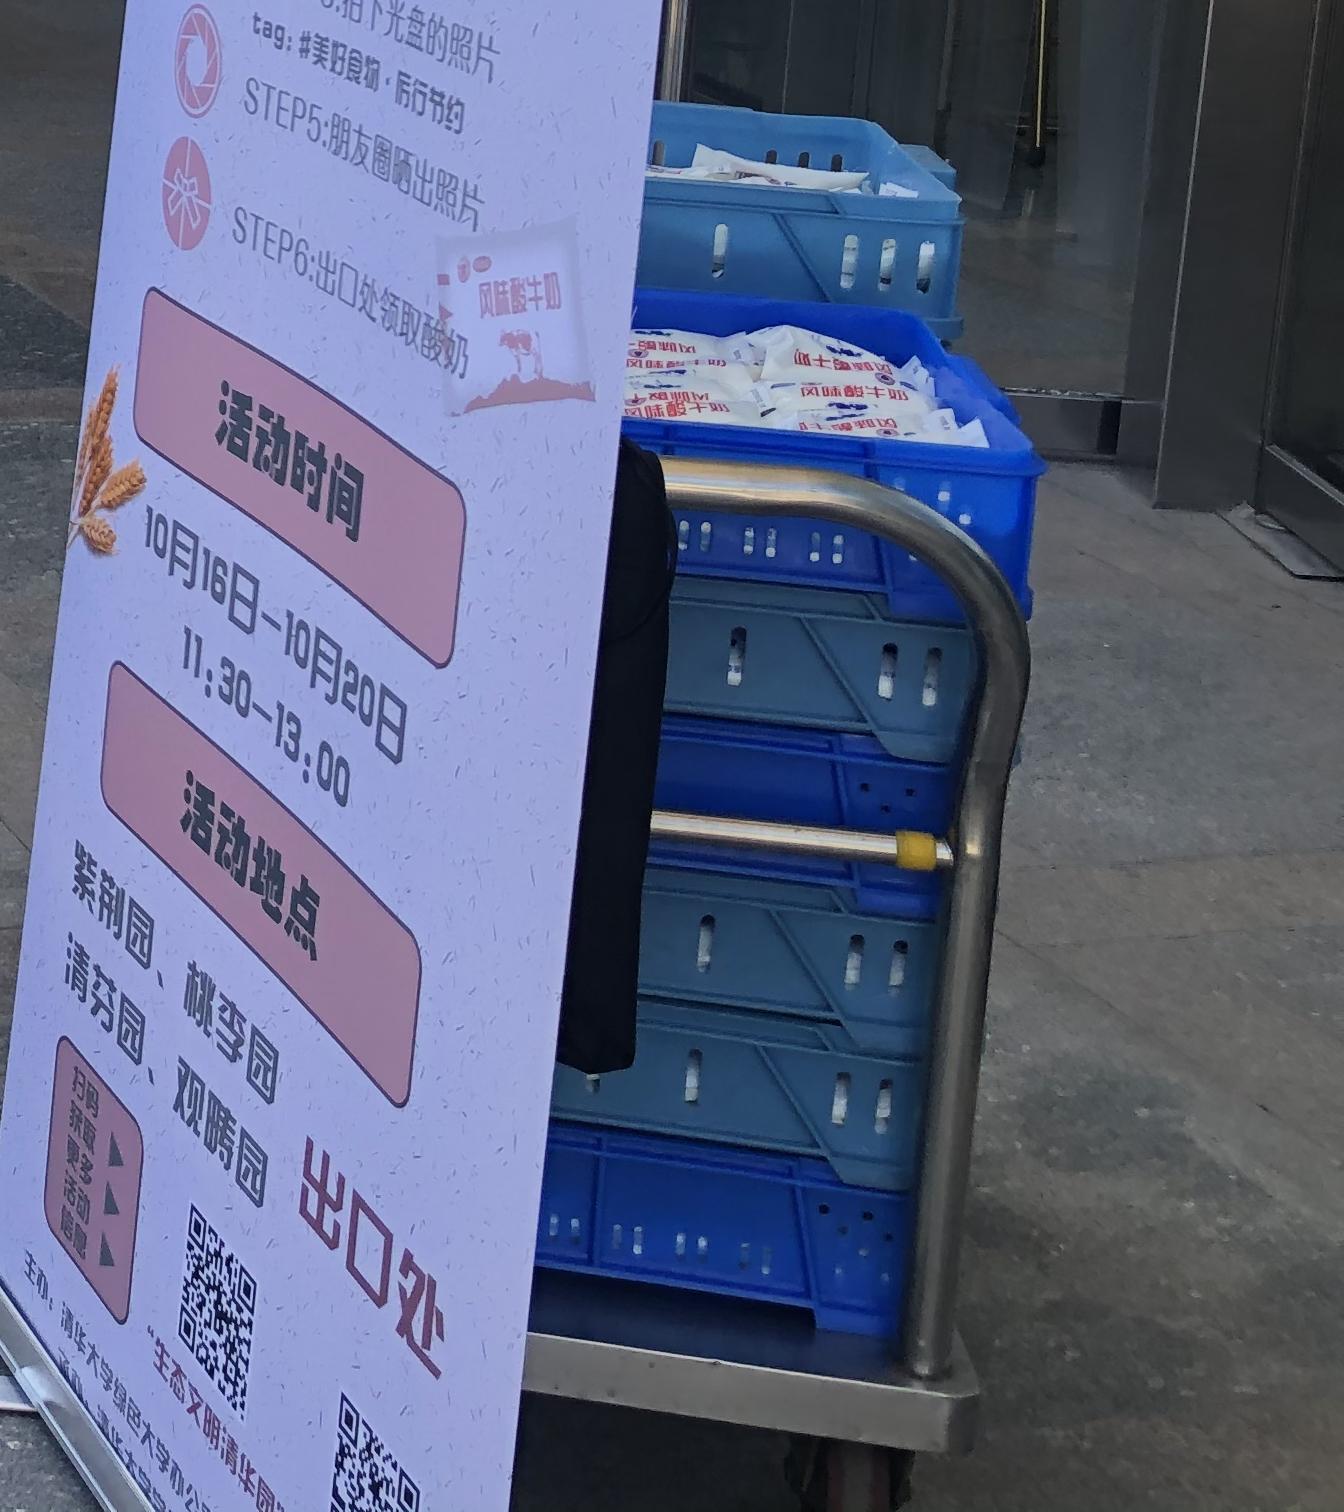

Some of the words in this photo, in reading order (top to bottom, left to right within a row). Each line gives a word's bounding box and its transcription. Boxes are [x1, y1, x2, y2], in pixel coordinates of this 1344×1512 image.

[243, 77, 487, 233] STEP5:朋友圈晒出照片
[231, 206, 470, 380] STEP6:出口处领取酸奶
[214, 379, 365, 543] 活动时间
[800, 384, 910, 402] 风味酸牛奶
[144, 504, 408, 765] 10月16日-10月20日
[181, 625, 352, 808] 11:30-13:00
[180, 769, 321, 961] 活动地点
[66, 1133, 95, 1186] 更多
[71, 1065, 100, 1118] 扫码
[63, 1168, 91, 1226] 活动
[298, 1135, 446, 1380] 出口处
